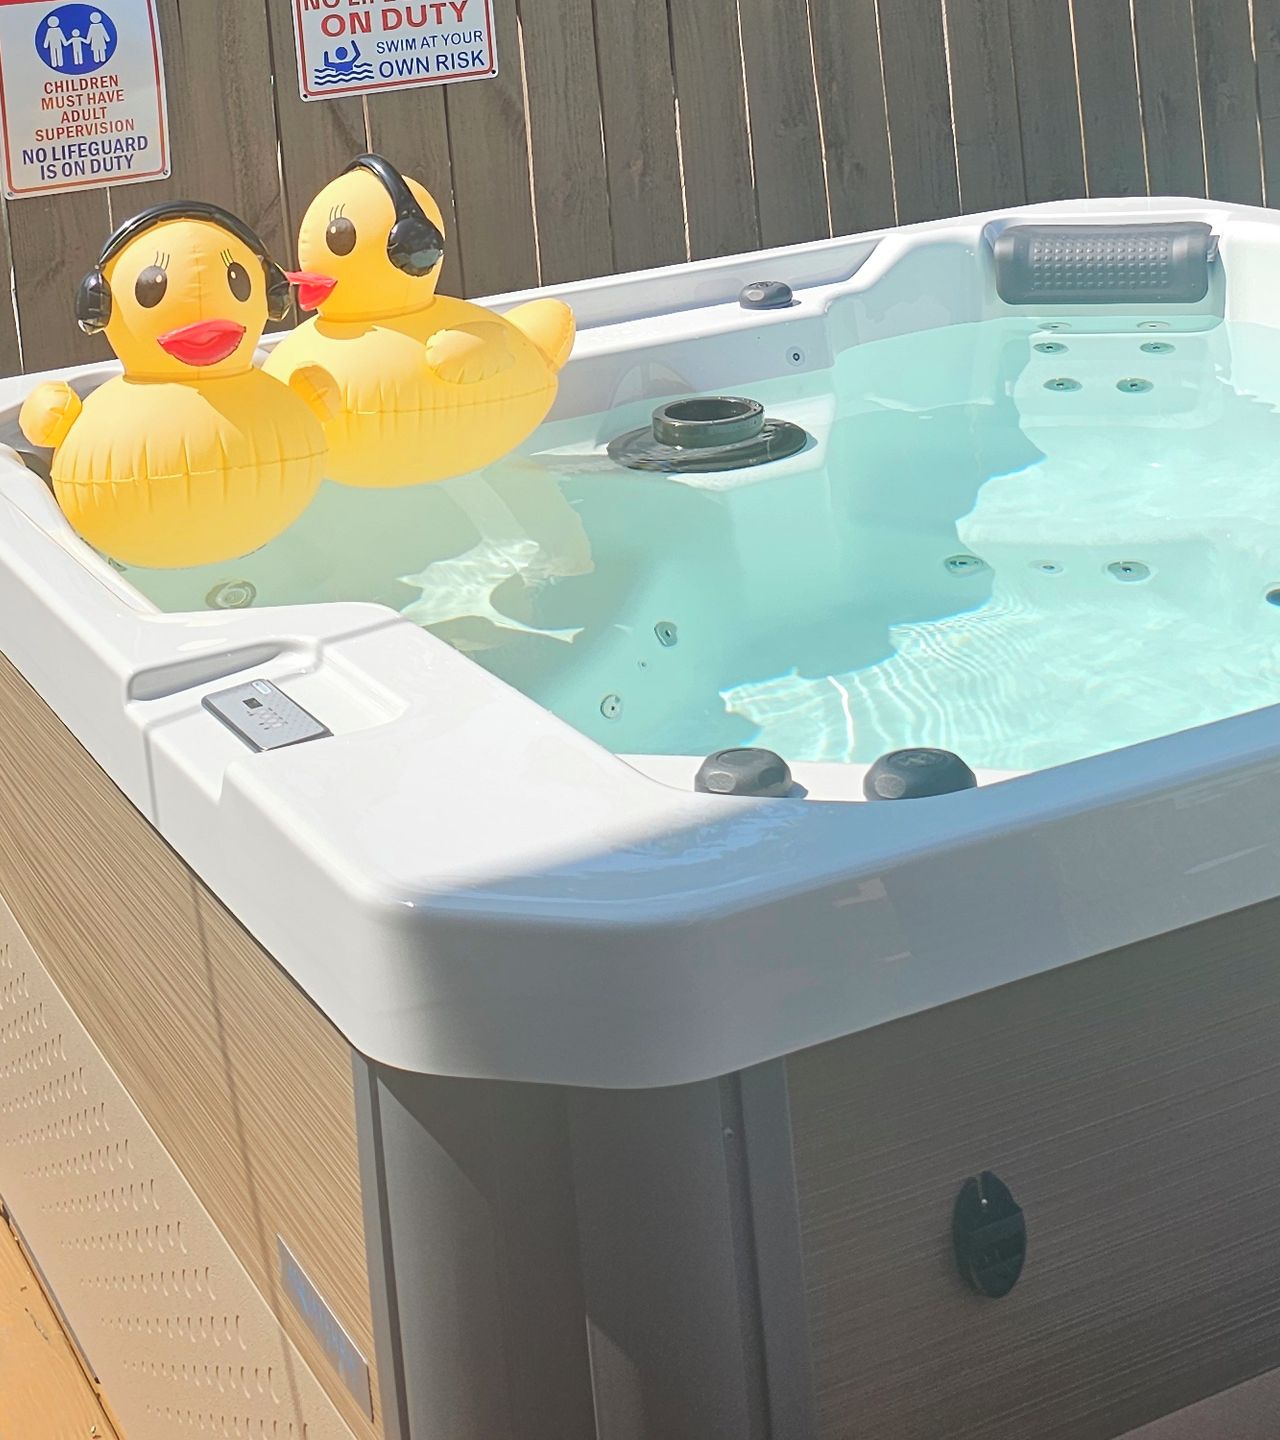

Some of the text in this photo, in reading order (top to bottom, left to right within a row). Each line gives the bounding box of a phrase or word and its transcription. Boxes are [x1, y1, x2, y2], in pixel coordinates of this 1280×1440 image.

[321, 0, 468, 37] ON DUTY
[376, 30, 483, 54] SWIM AT YOUR
[379, 49, 485, 78] OWN RISK
[44, 74, 118, 95] CHILDREN
[41, 89, 124, 110] MUST HAVE
[60, 106, 107, 124] ADULT
[35, 118, 134, 142] SUPERVISION
[22, 135, 148, 165] NO LIFEGUARD
[40, 153, 134, 180] IS ON DUTY
